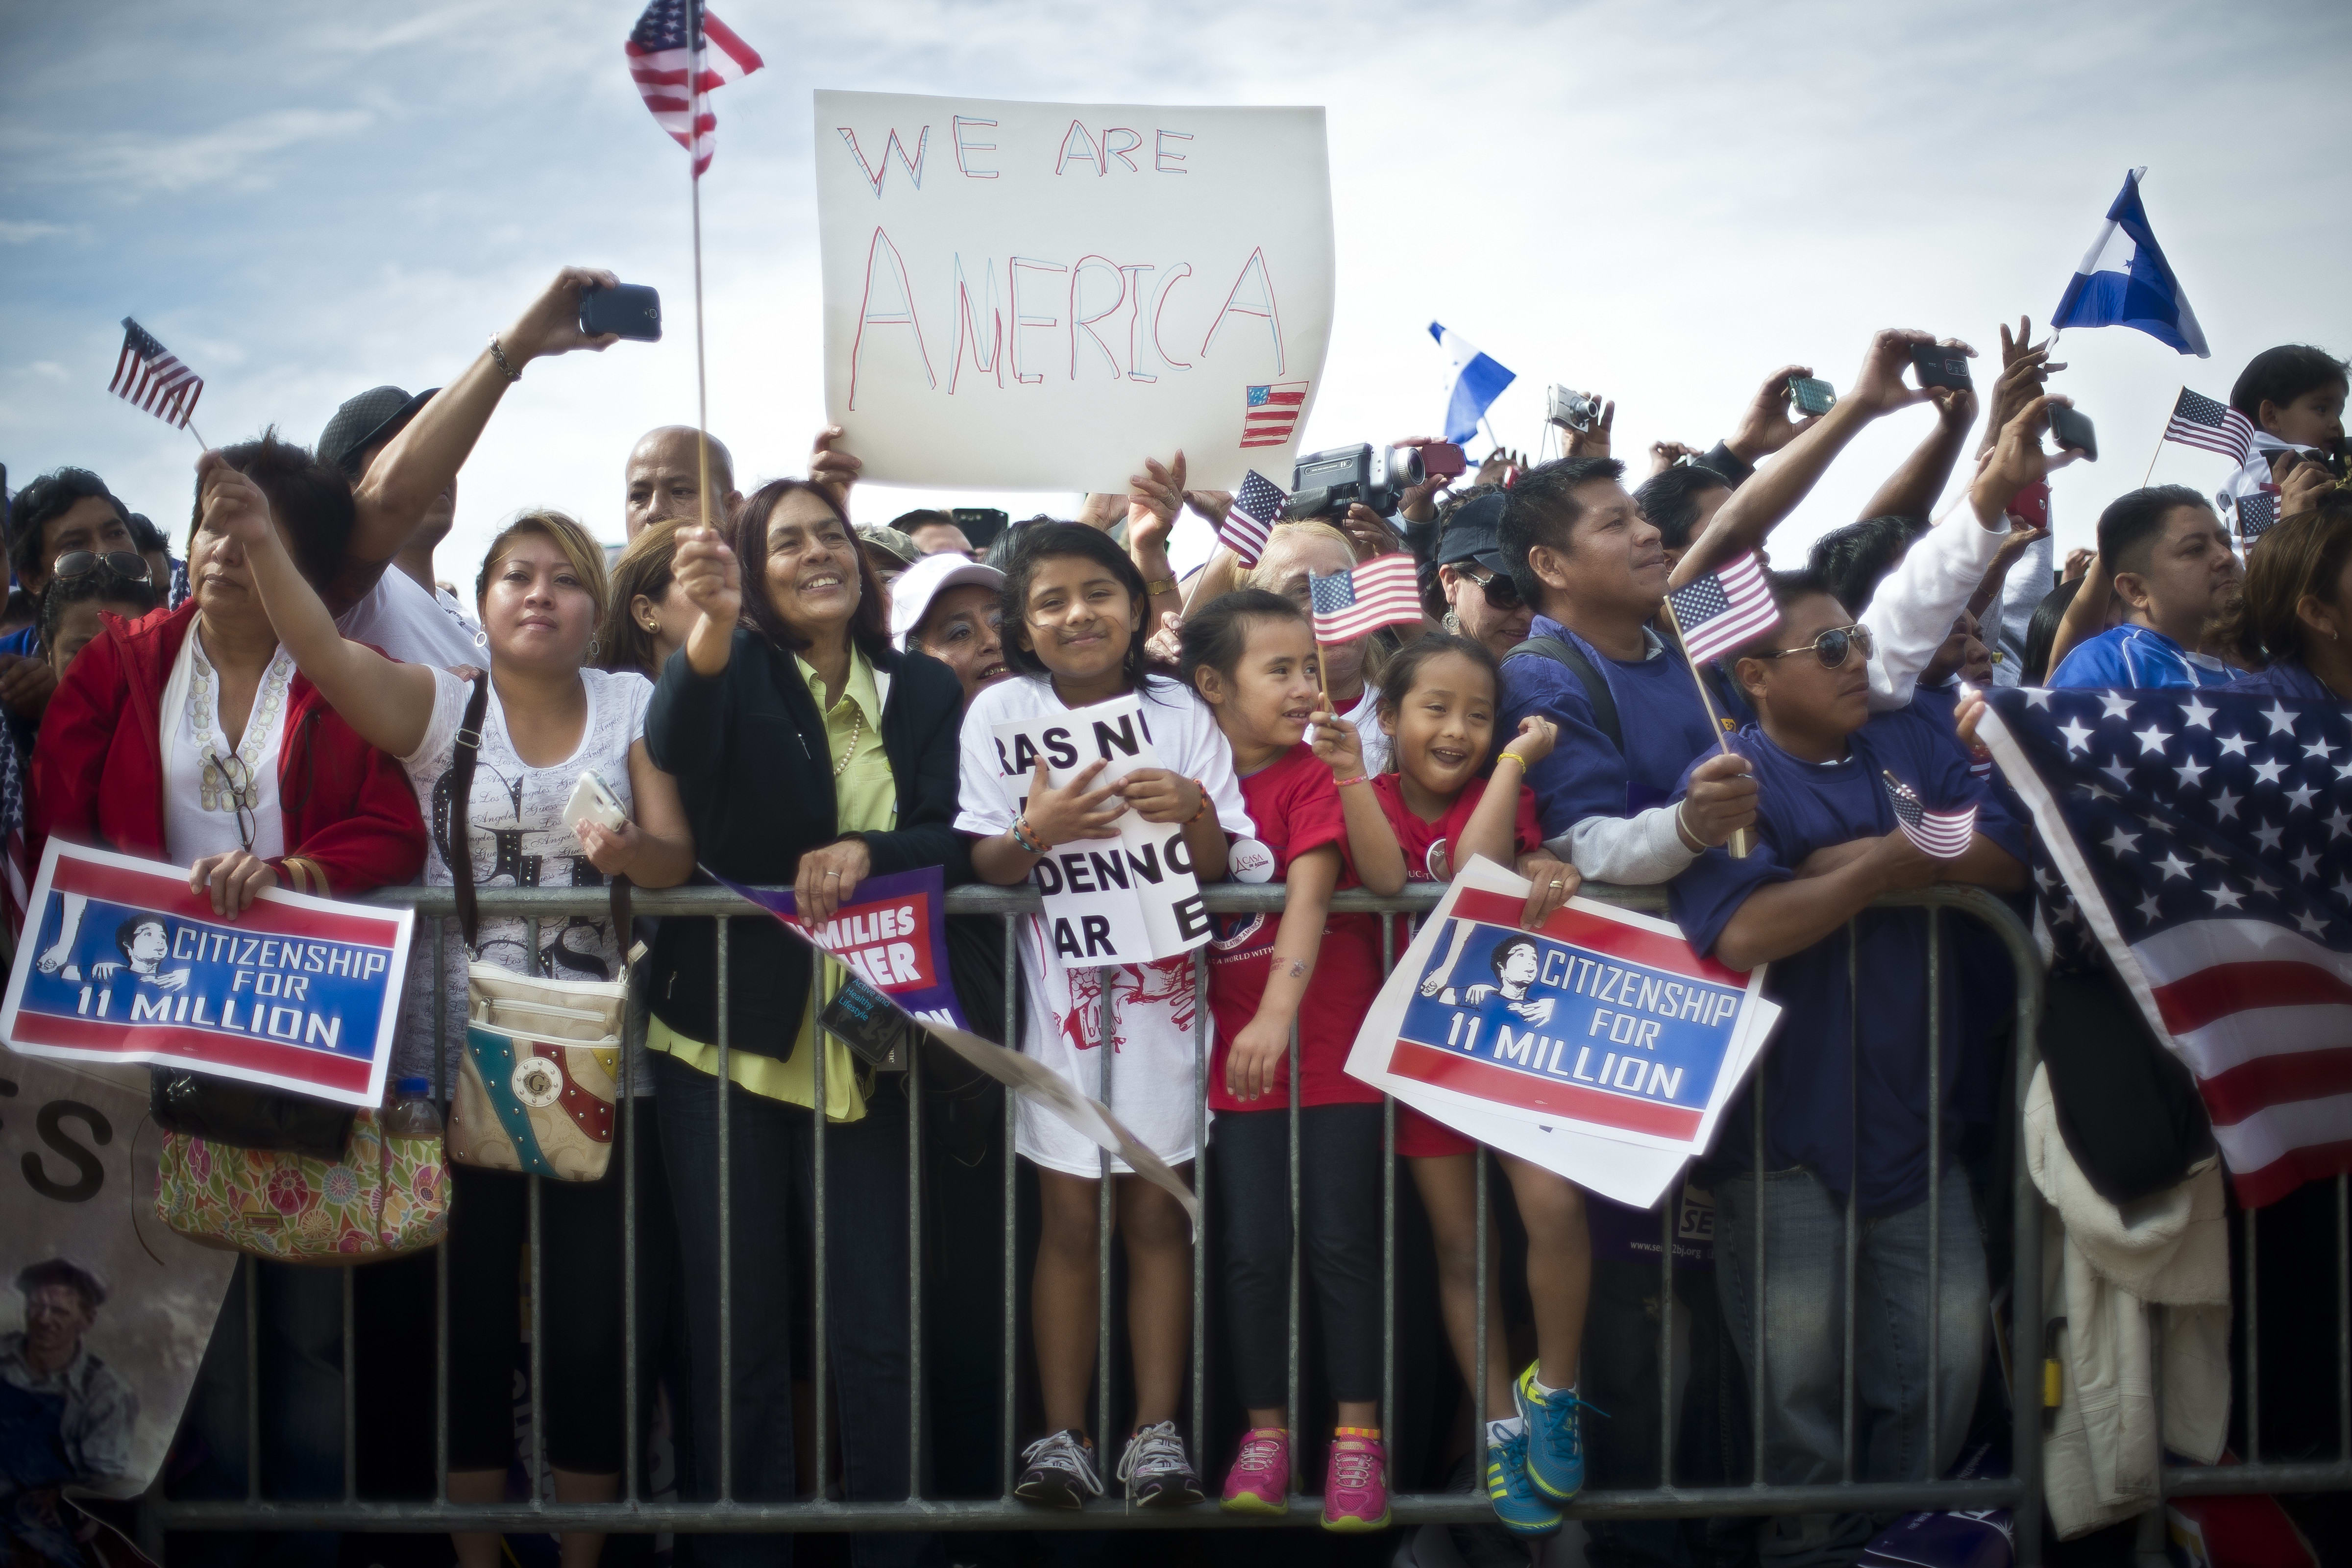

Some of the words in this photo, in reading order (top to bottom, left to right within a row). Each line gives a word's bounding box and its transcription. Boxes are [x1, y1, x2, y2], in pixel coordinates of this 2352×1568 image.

[837, 115, 999, 200] WE
[1056, 120, 1194, 177] ARE
[848, 226, 1285, 412] AMERICA
[1093, 708, 1153, 761] N
[480, 791, 500, 804] Los
[525, 802, 559, 817] Guess
[539, 816, 562, 829] Los
[467, 832, 495, 846] ngeles
[531, 831, 577, 848] Angele
[1242, 854, 1263, 864] CASA
[172, 926, 386, 980] CITIZENSHIP
[500, 954, 521, 966] Los
[1224, 953, 1250, 963] WORLD
[233, 969, 310, 1001] FOR
[853, 978, 876, 997] Active
[875, 992, 891, 1007] and
[1539, 948, 1738, 1028] CITIZENSHIP
[838, 996, 869, 1021] Lifestyle
[846, 986, 874, 1010] Healthy
[77, 985, 111, 1018] 11
[130, 994, 342, 1049] MILLION
[1588, 1007, 1662, 1051] FOR
[1447, 1010, 1480, 1051] 11
[1493, 1024, 1683, 1099] MILLION
[1630, 1242, 1701, 1259] www.sei2bj.org
